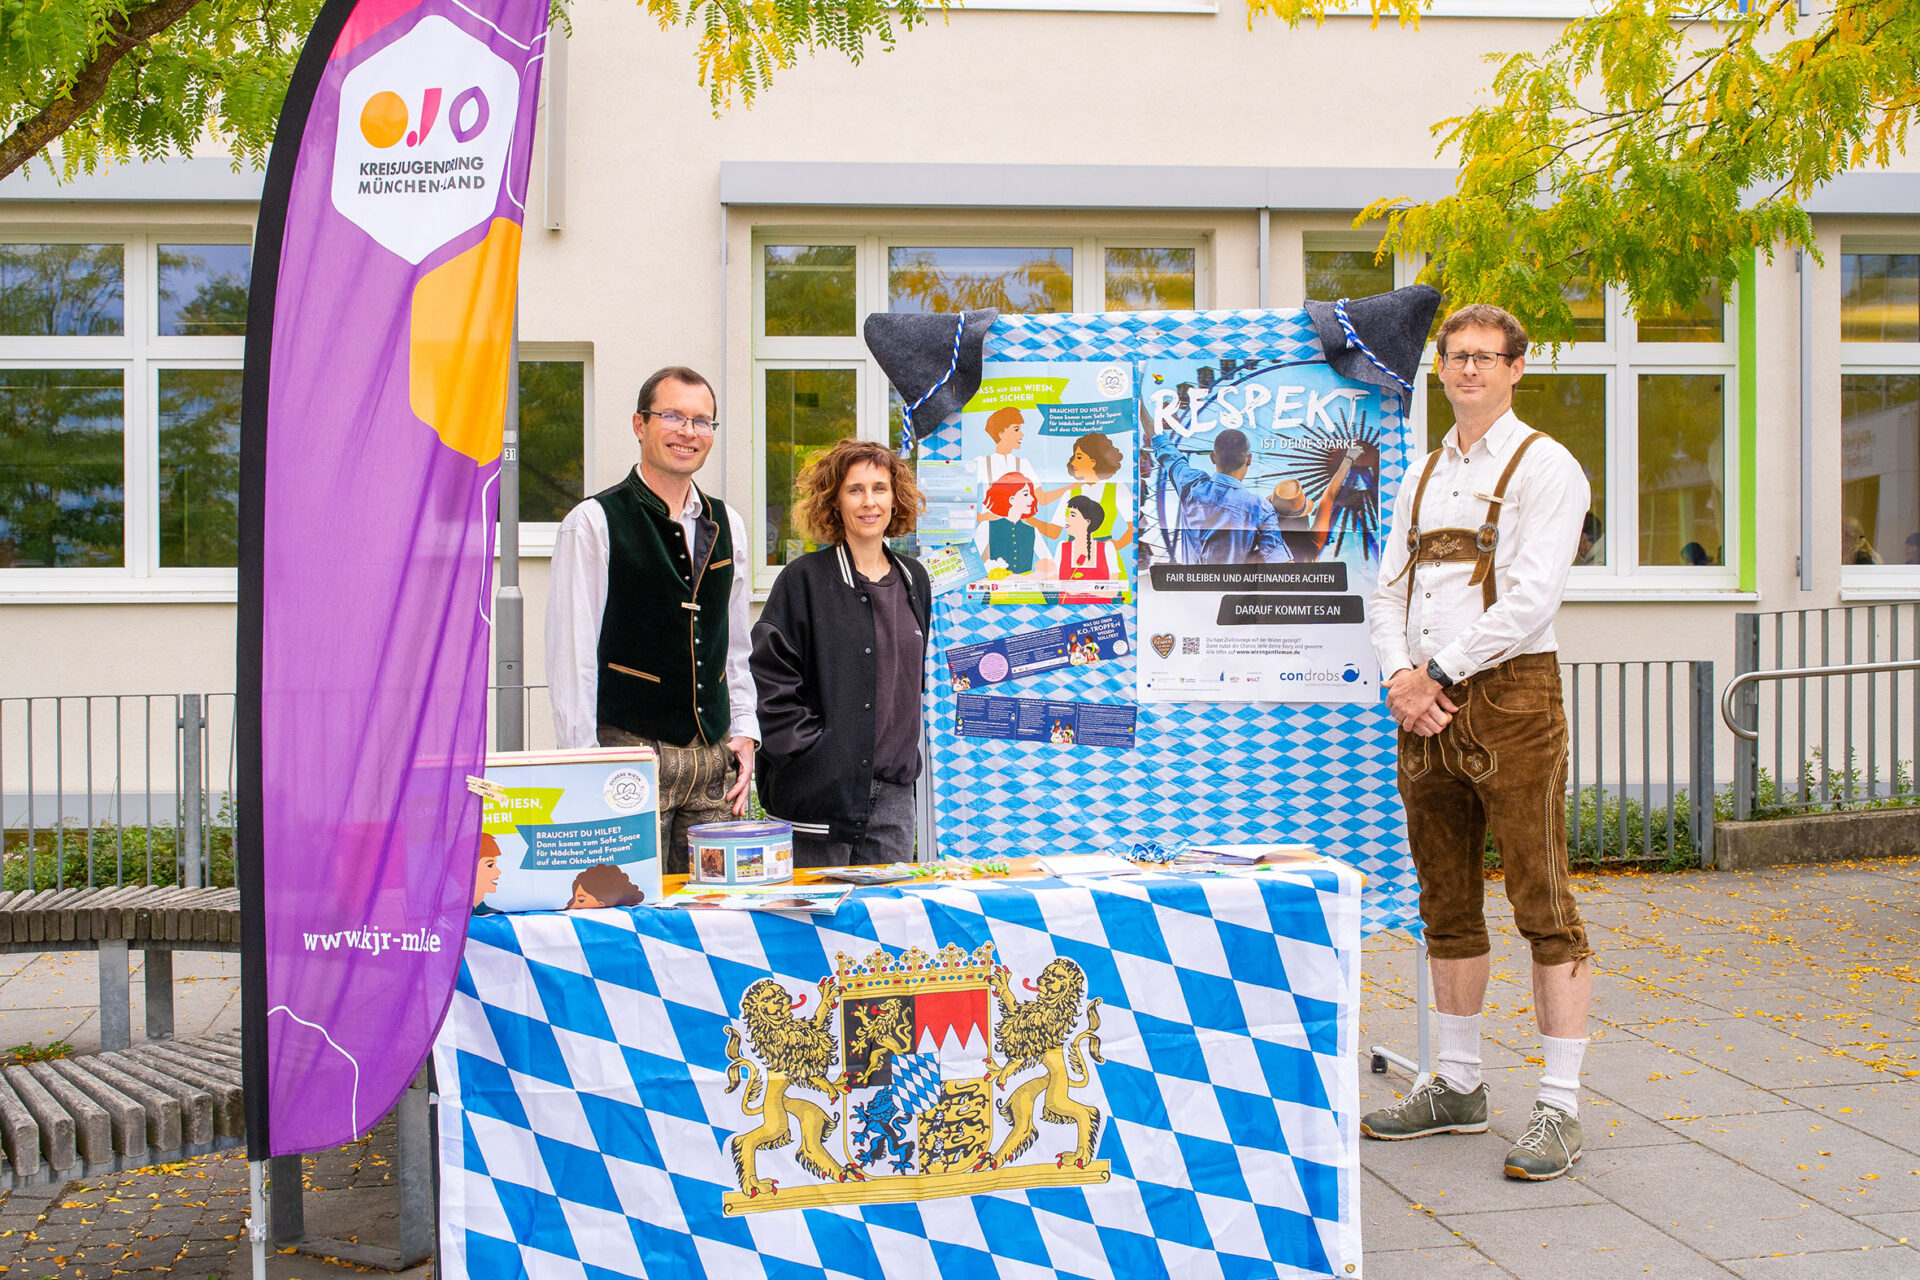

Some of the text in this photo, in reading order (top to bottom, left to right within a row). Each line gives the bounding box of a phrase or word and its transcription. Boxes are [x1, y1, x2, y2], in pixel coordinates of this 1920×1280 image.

[359, 157, 484, 176] KREISJUGENDRING
[358, 176, 485, 194] MÜNCHEN-LAND
[1024, 384, 1054, 393] WIESN,
[1000, 393, 1034, 402] SICHER!
[1150, 383, 1371, 438] RESPEKT
[1260, 438, 1277, 449] IST
[1280, 438, 1313, 449] DEINE
[505, 449, 515, 460] 31
[1166, 573, 1335, 583] FAIR BLEIBEN UND AUFEINANDER ACHTEN
[1235, 605, 1341, 615] DARAUF KOMMT ES AN
[1280, 668, 1340, 682] condrobs
[499, 798, 543, 810] WIESN,
[483, 812, 512, 824] HER!
[536, 826, 622, 839] BRAUCHST DU HILFE?
[618, 834, 641, 843] Space
[536, 849, 548, 857] für
[588, 847, 602, 855] und
[569, 854, 614, 864] Oktoberfest!
